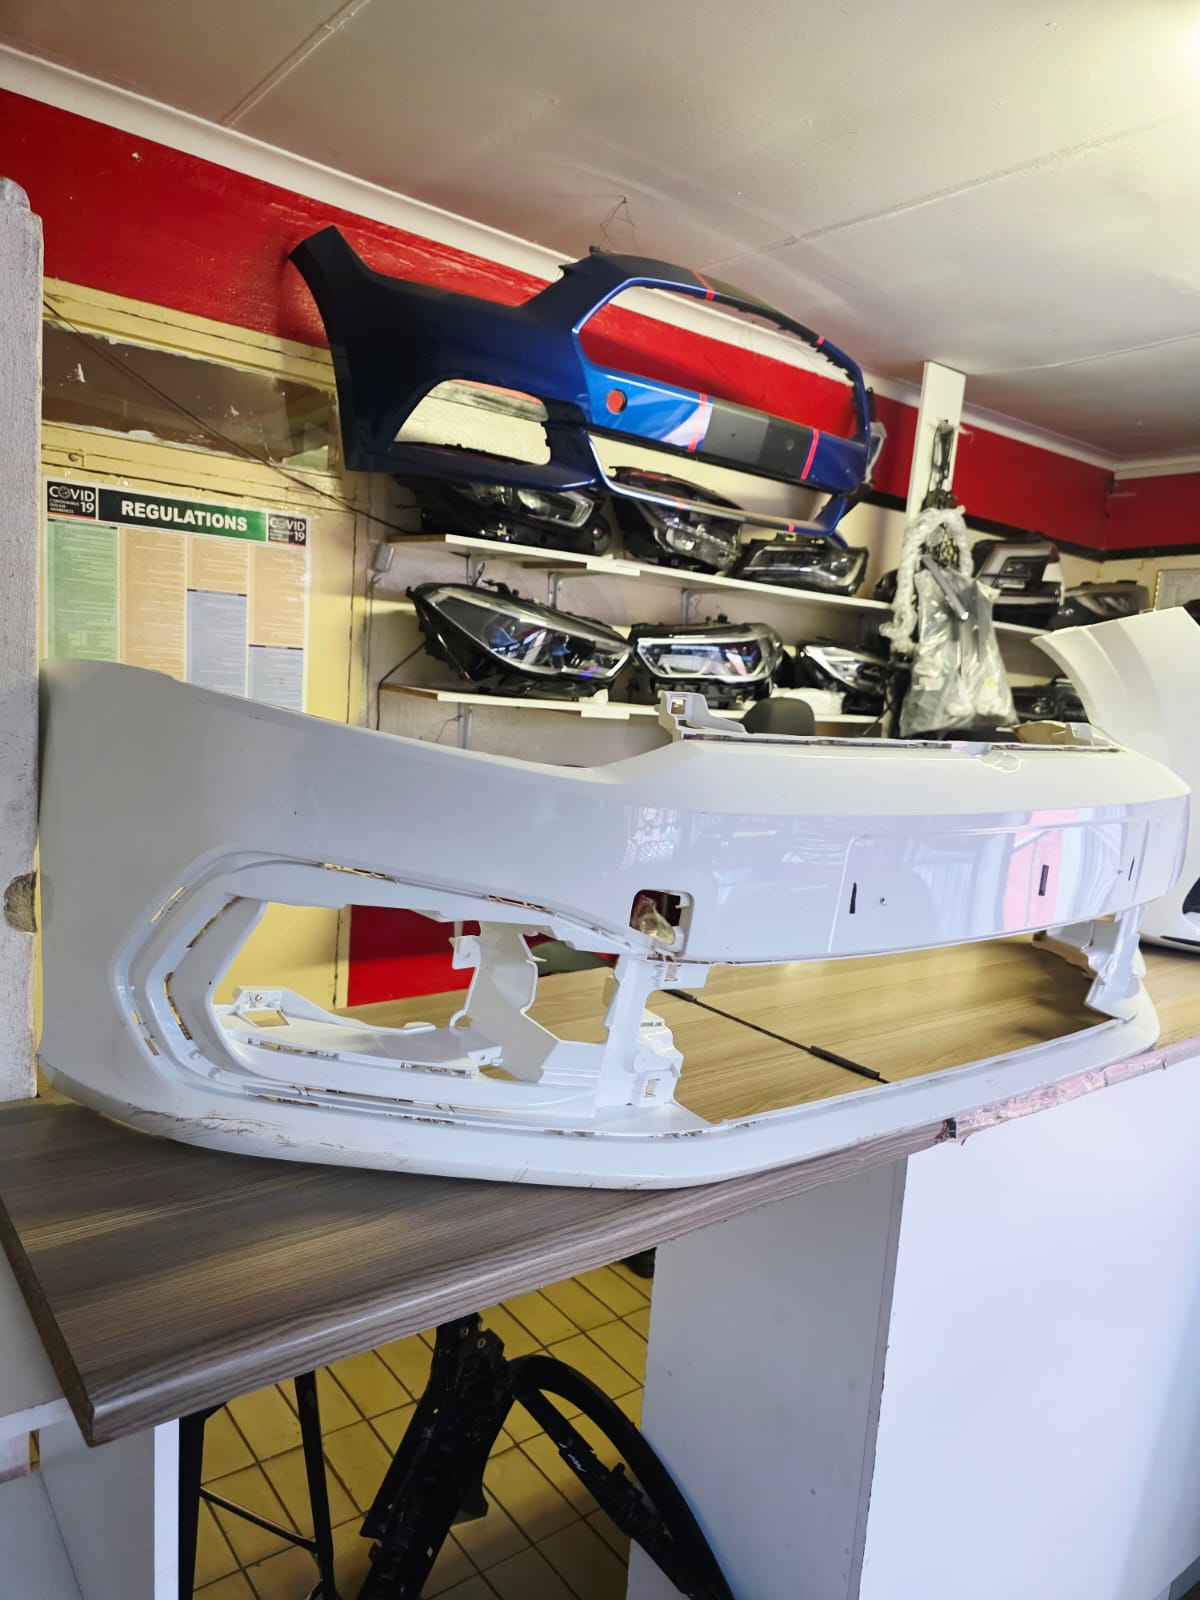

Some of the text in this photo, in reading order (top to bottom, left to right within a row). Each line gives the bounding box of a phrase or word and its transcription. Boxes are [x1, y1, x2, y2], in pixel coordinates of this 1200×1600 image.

[49, 486, 95, 502] COVID
[80, 501, 94, 513] 19
[121, 500, 247, 531] REGULATIONS
[270, 517, 305, 531] COVID
[294, 531, 305, 541] 19
